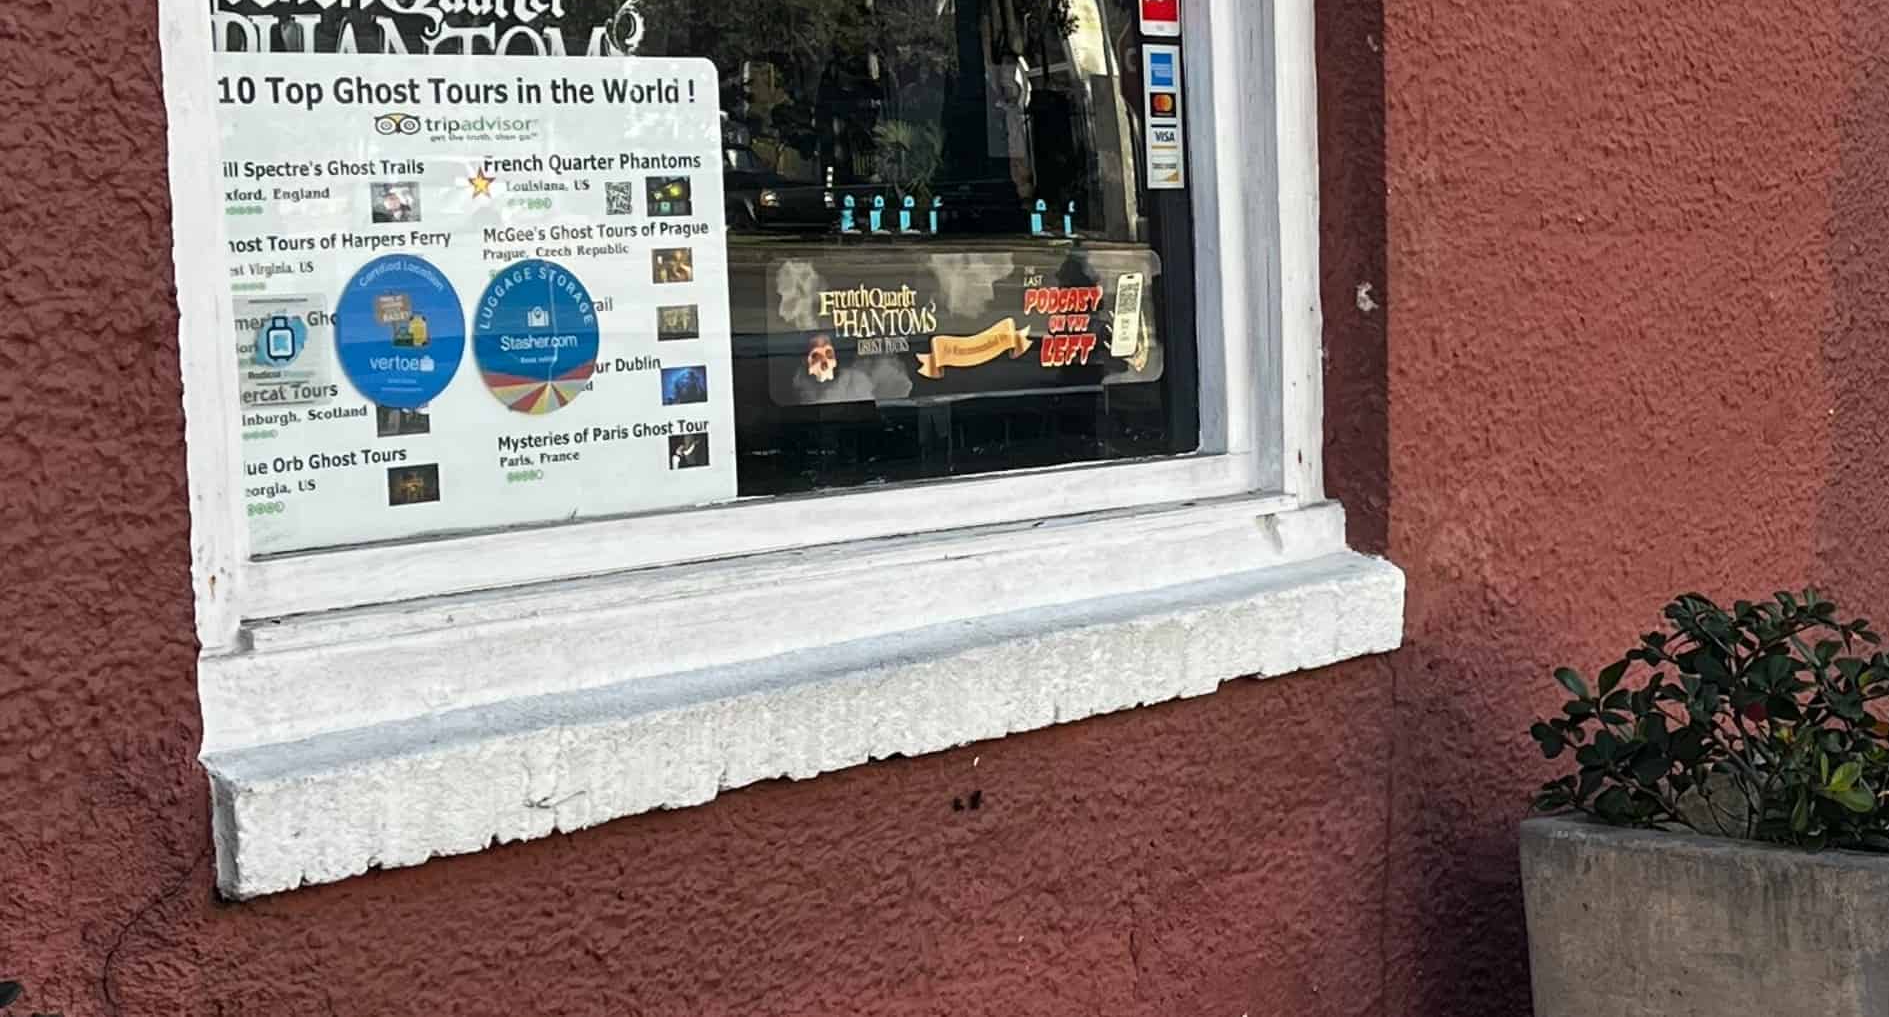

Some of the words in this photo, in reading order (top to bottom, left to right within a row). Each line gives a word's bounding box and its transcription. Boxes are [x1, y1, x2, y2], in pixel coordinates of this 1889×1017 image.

[217, 76, 256, 104] 10
[265, 76, 323, 111] Top
[333, 76, 420, 105] Ghost
[427, 77, 509, 104] Tours
[516, 77, 541, 104] in
[550, 77, 594, 104] the
[602, 78, 679, 104] World
[424, 116, 532, 133] tripadvisor
[1154, 130, 1176, 143] VISA
[223, 161, 238, 177] ill
[244, 160, 323, 181] Spectre's
[327, 160, 376, 176] Ghost
[380, 158, 425, 175] Trails
[483, 154, 543, 173] French
[549, 153, 615, 175] Quarter
[620, 152, 702, 170] Phantoms
[573, 179, 591, 191] US
[225, 188, 267, 201] xford,
[272, 187, 330, 203] England
[266, 235, 316, 251] Tours
[320, 233, 337, 250] of
[342, 233, 406, 251] Harpers
[410, 231, 451, 248] Ferry
[483, 226, 546, 243] McGee's
[550, 224, 594, 240] Ghost
[598, 223, 638, 238] Tours
[641, 221, 657, 236] of
[660, 221, 709, 239] Prague
[535, 246, 572, 258] Czech
[577, 243, 629, 258] Republic
[299, 261, 314, 273] US
[1024, 274, 1043, 287] LAST
[479, 267, 532, 330] LUGGAGE
[538, 267, 594, 326] STORAGE
[592, 297, 613, 312] ail
[1024, 286, 1104, 315] PODCAST
[832, 305, 937, 338] PHANTOMS
[1041, 333, 1097, 367] LEFT
[369, 354, 419, 371] vertoe
[615, 354, 661, 372] Dublin
[242, 385, 287, 404] ercat
[290, 383, 339, 400] Tours
[308, 404, 368, 422] Scotland
[498, 431, 570, 453] Mysteries
[574, 427, 590, 444] of
[593, 425, 629, 442] Paris
[632, 421, 673, 438] Ghost
[677, 419, 709, 433] Tour
[273, 455, 304, 474] Orb
[308, 451, 357, 470] Ghost
[361, 448, 407, 464] Tours
[539, 451, 580, 464] France
[298, 479, 317, 492] US
